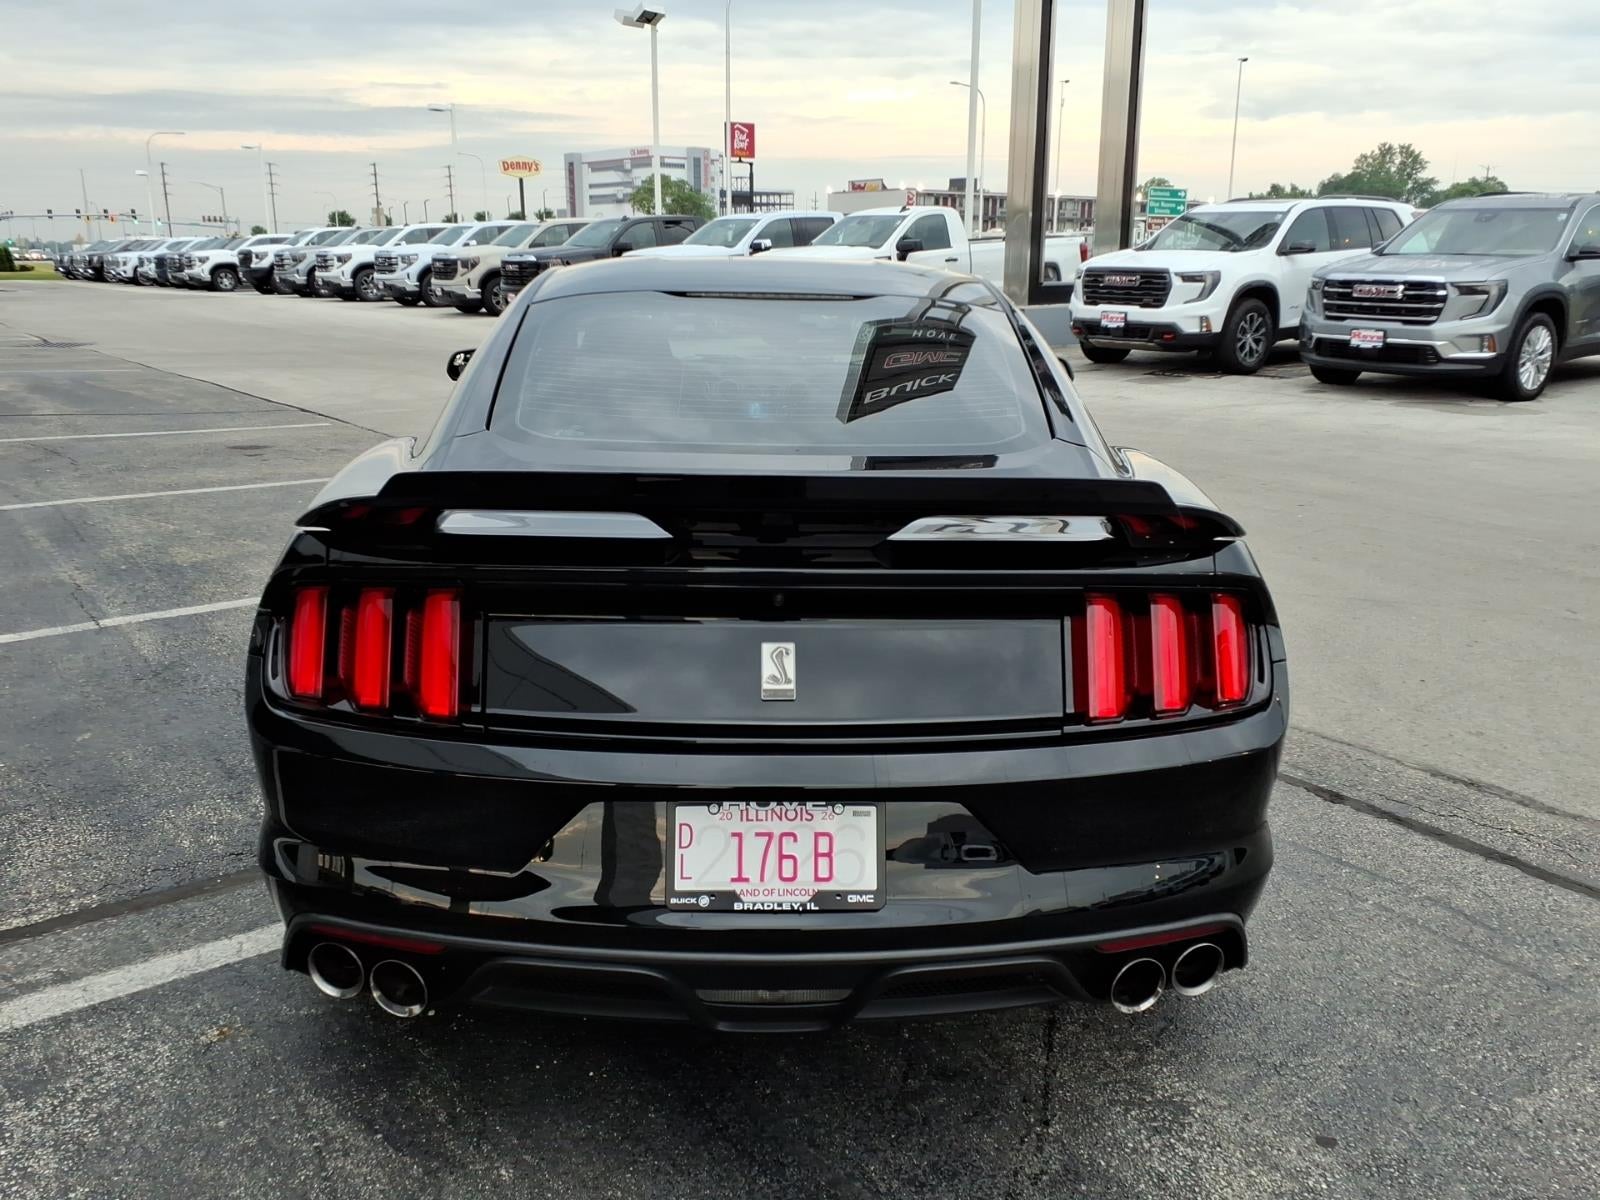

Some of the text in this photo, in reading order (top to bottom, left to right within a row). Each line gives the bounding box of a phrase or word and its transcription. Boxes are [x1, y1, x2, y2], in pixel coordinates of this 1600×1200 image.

[502, 160, 540, 172] Denny's
[1103, 275, 1140, 287] GMC
[1352, 284, 1405, 299] GMC
[719, 807, 835, 822] 20 ILLINOIS 26
[730, 831, 834, 883] 176 B
[738, 888, 760, 897] AND
[762, 888, 776, 897] OF
[847, 894, 874, 903] GMC
[733, 902, 820, 911] BRADLEY, IL
